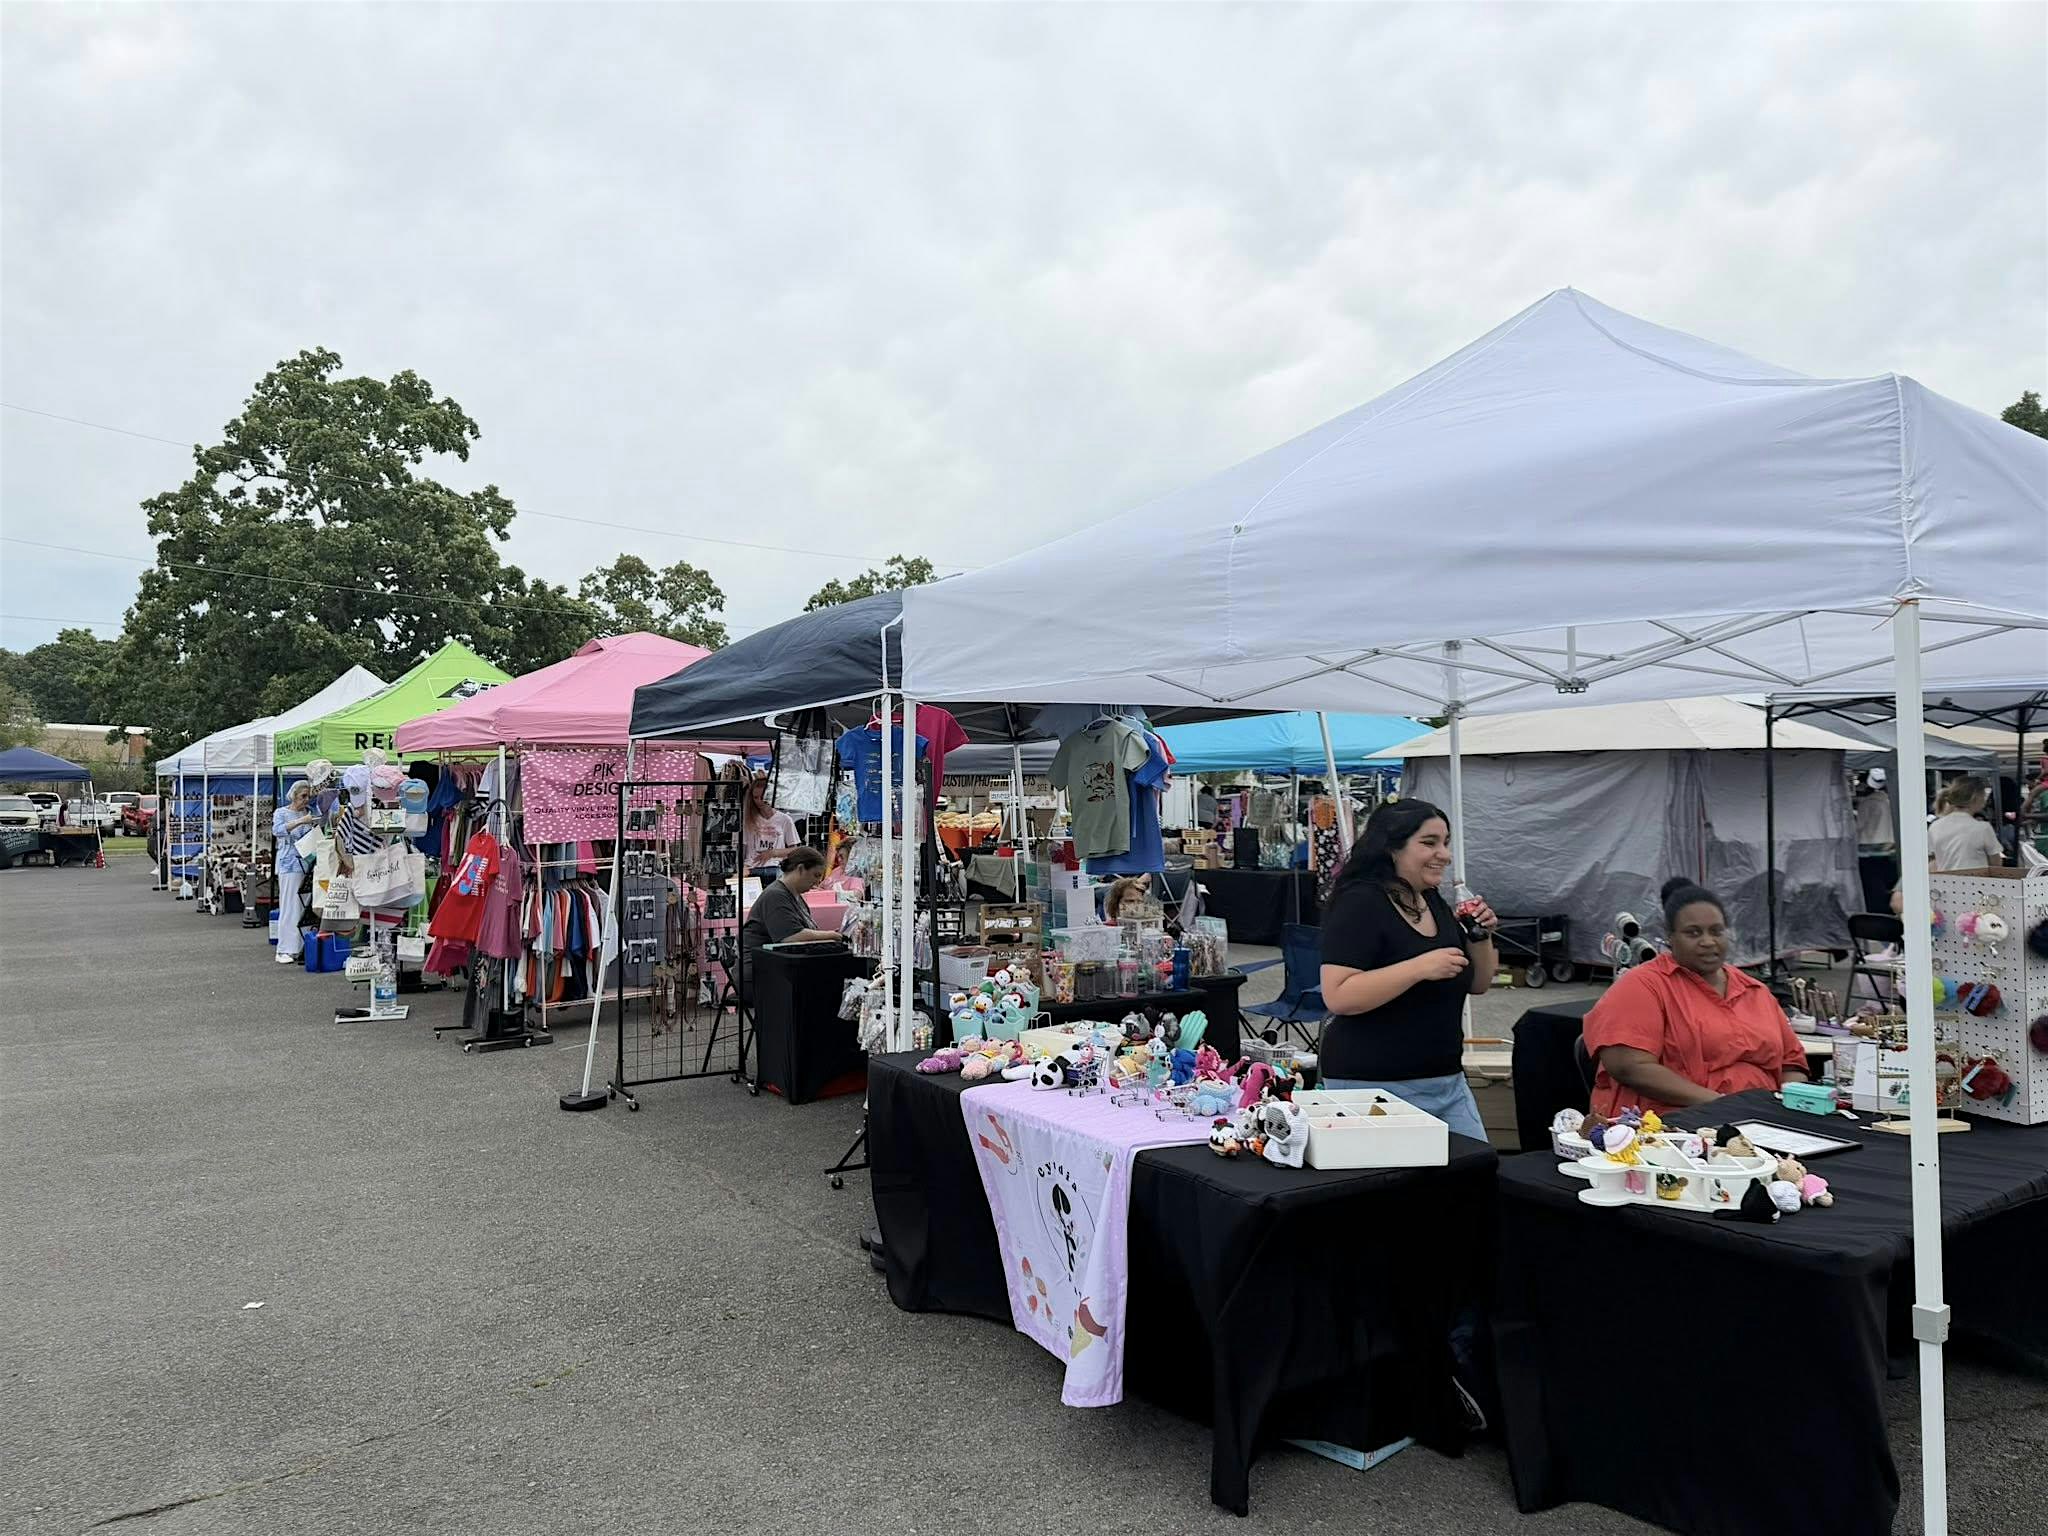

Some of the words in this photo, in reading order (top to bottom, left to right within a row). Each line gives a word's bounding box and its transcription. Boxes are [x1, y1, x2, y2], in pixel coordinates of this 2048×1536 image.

[355, 732, 393, 750] RE
[574, 782, 620, 796] DESIG
[534, 806, 570, 814] QUALITY
[572, 805, 594, 813] VINYL
